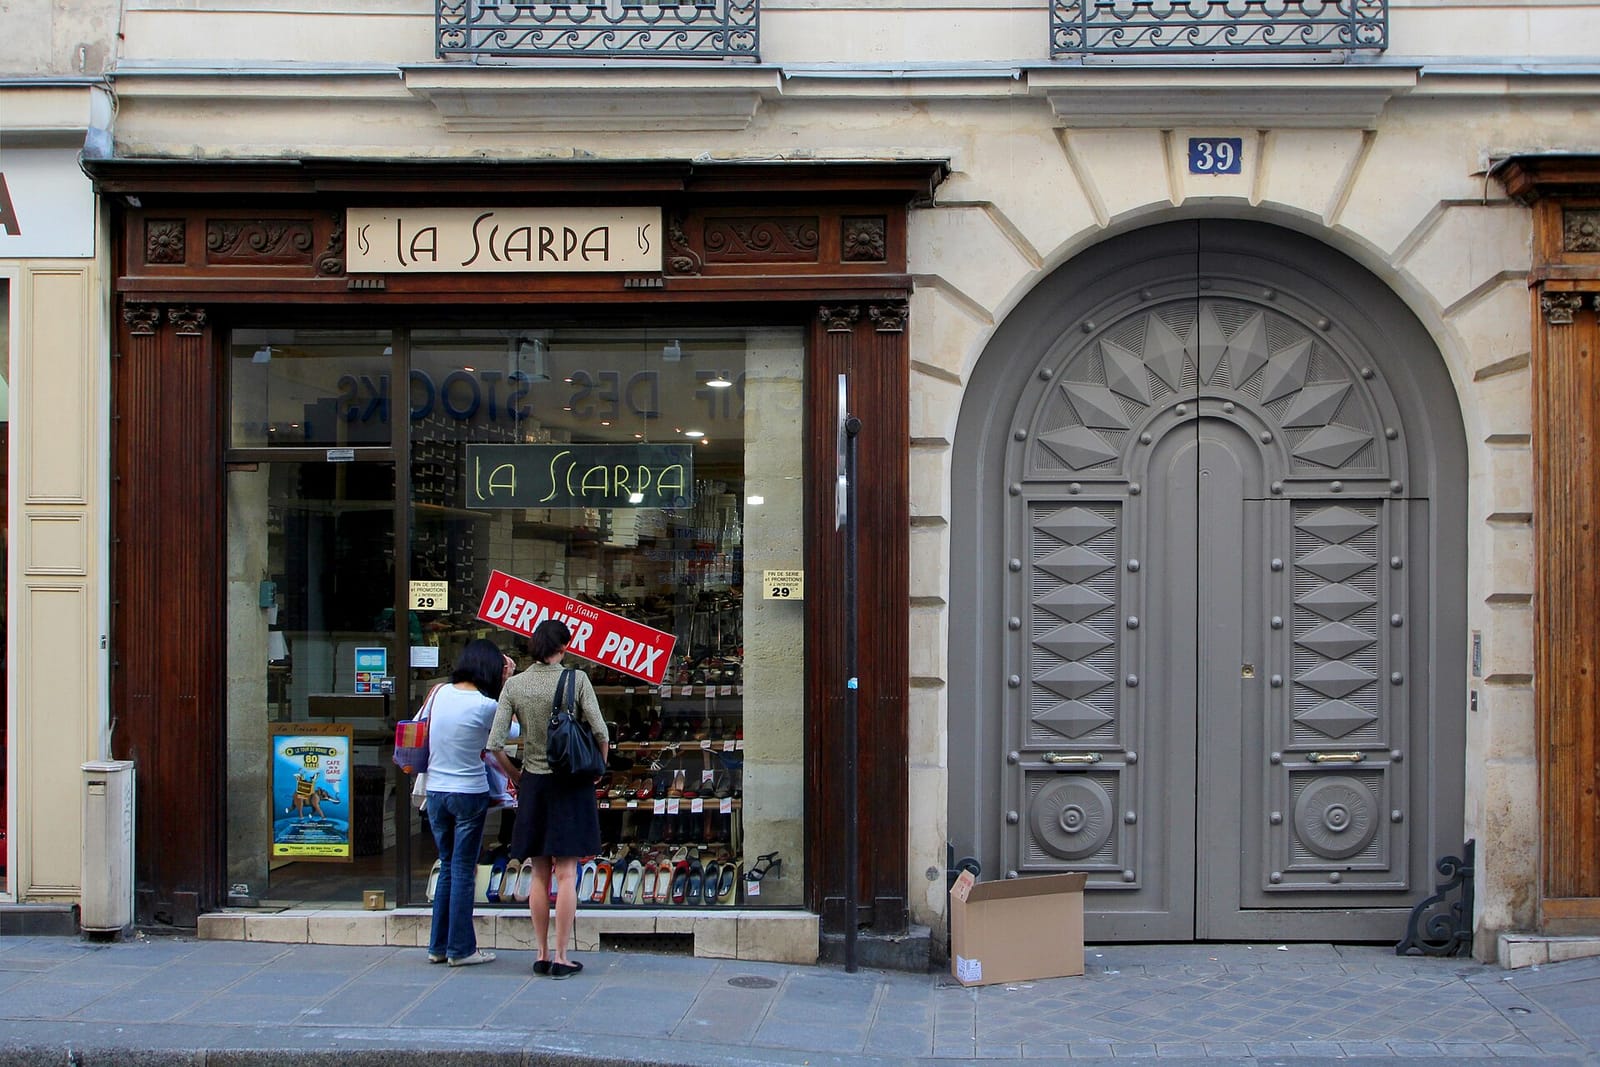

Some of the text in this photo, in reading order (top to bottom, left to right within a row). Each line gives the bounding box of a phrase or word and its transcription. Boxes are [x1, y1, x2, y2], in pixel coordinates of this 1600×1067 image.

[1197, 142, 1234, 170] 39
[397, 212, 610, 267] LA SCARPA
[476, 456, 515, 500] LA
[540, 450, 683, 502] SCARPA
[417, 598, 434, 607] 29
[772, 587, 790, 597] 29
[597, 631, 664, 678] PRIX
[305, 755, 318, 763] 80
